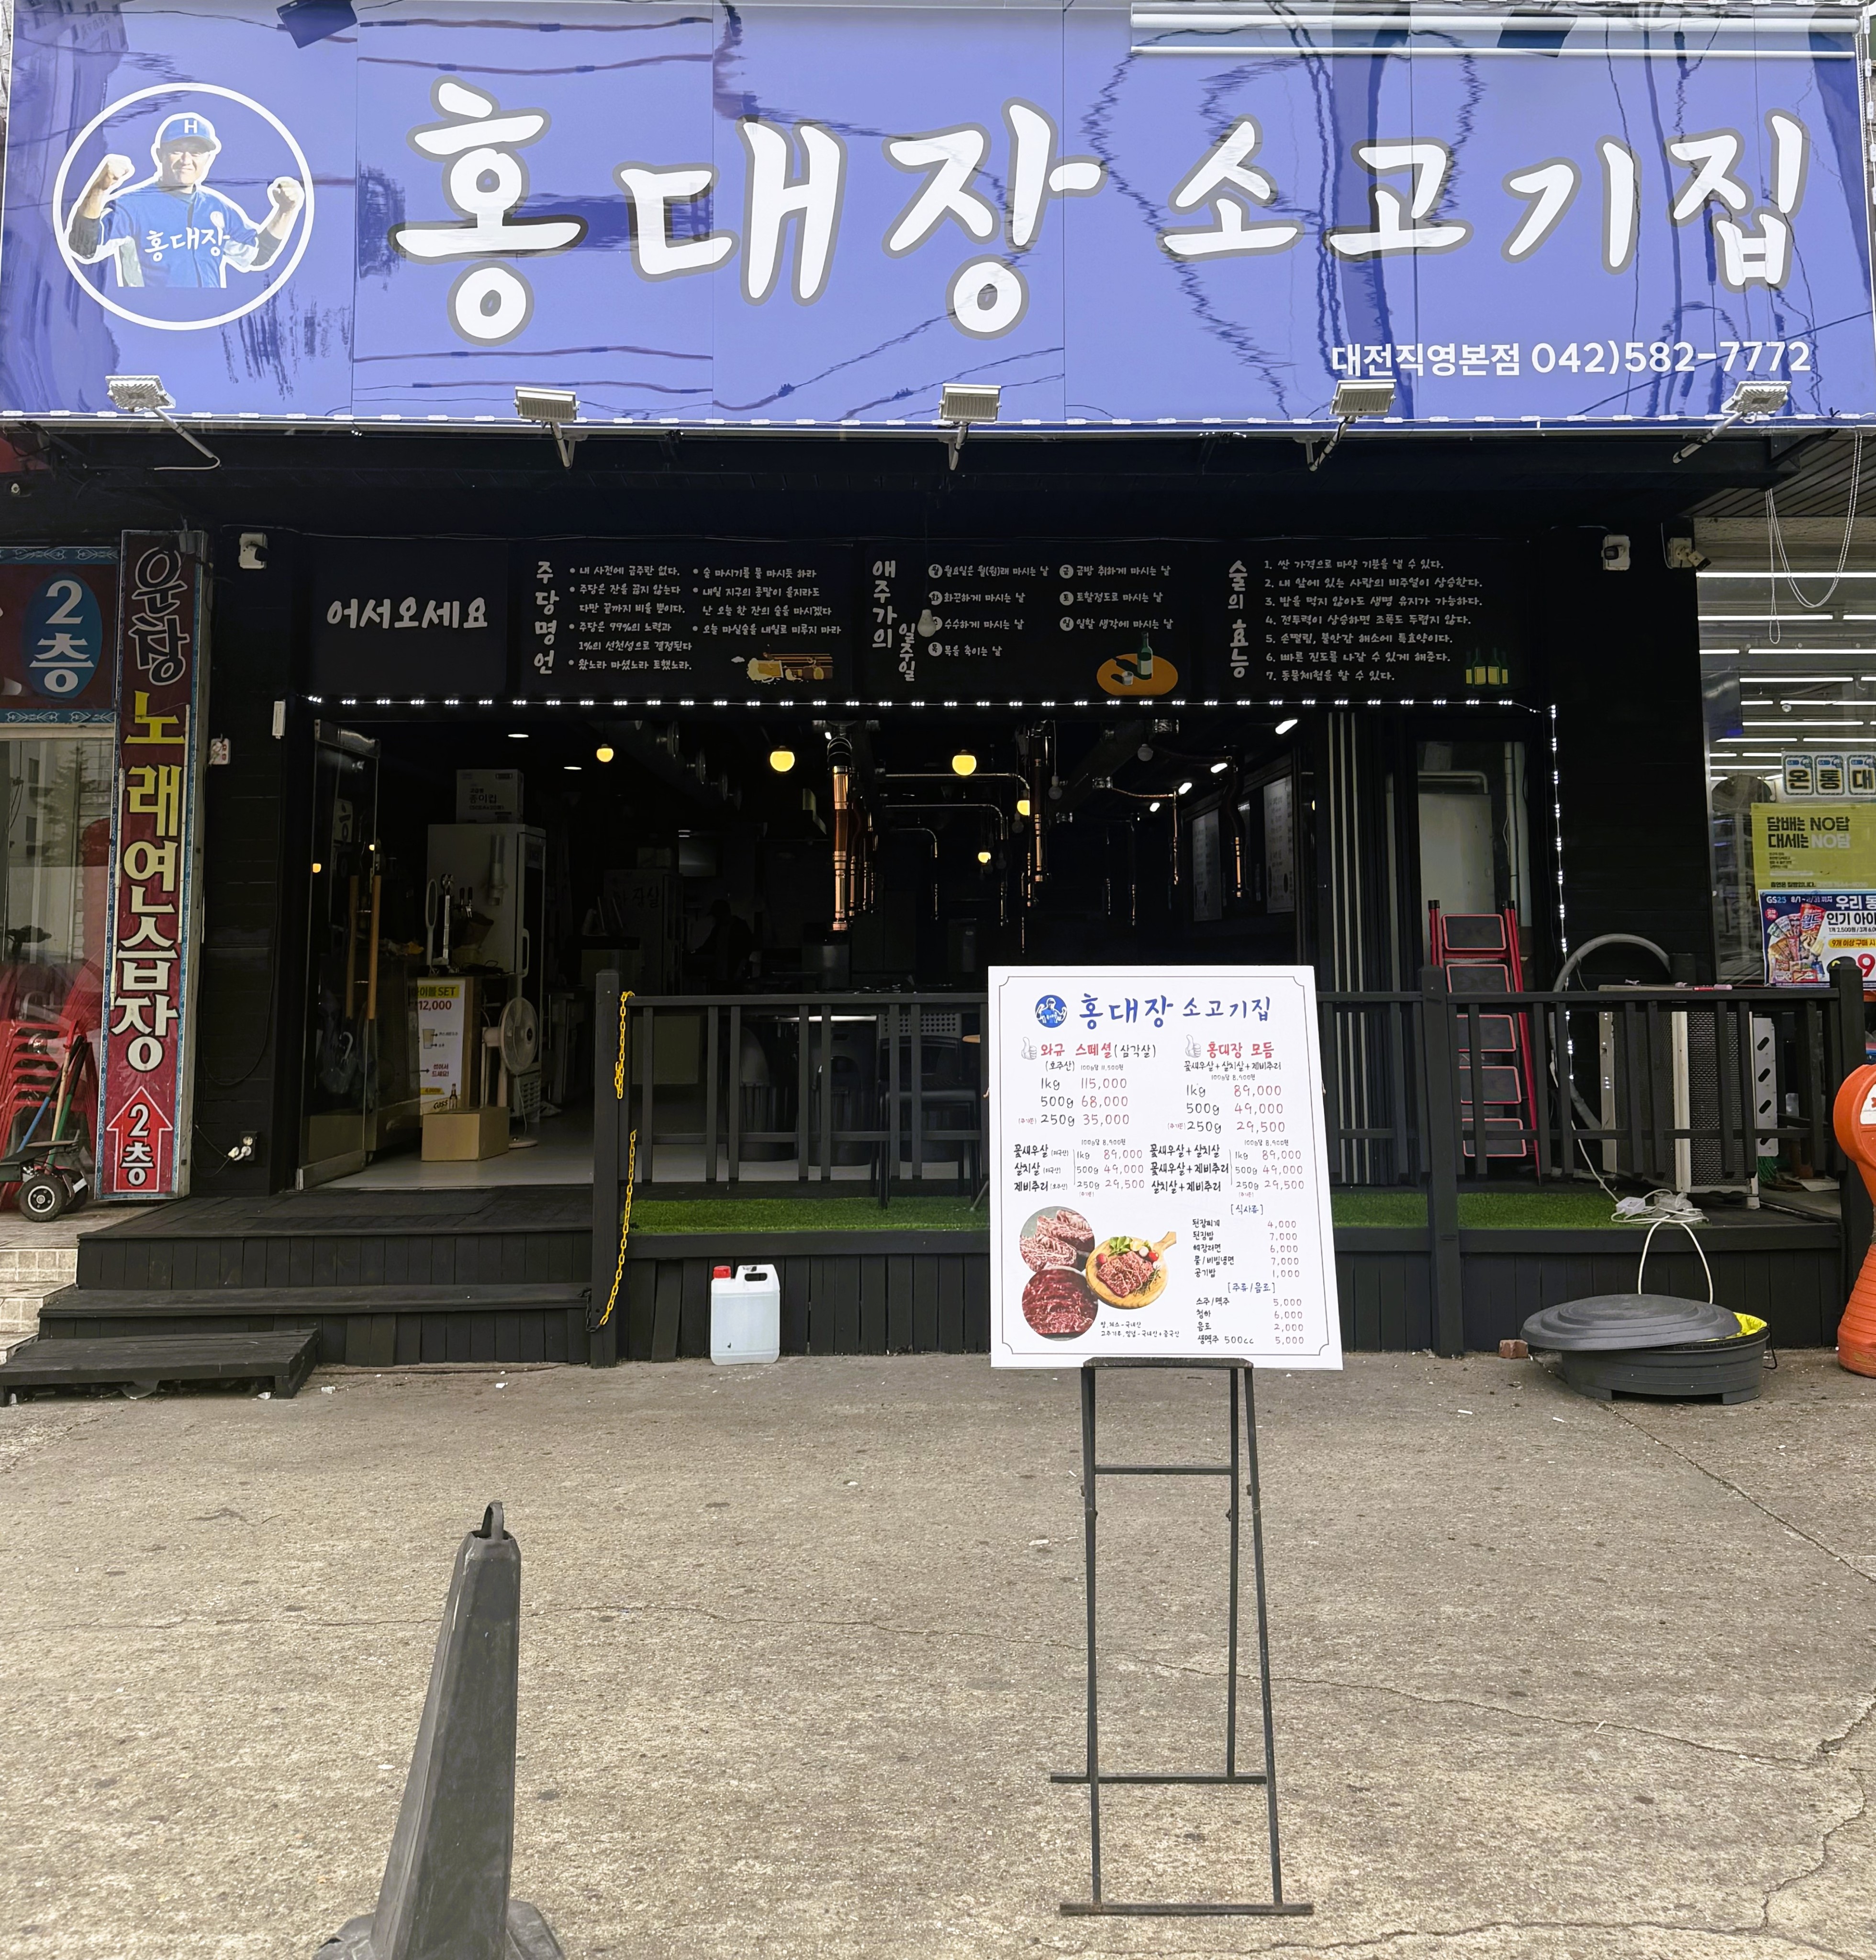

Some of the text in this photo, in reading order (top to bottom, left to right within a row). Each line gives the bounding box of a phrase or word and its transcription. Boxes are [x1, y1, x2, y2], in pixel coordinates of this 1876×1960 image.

[184, 119, 197, 133] H
[395, 78, 1809, 341] 홍대장 소고기집
[145, 227, 230, 262] 홍대장
[1331, 341, 1811, 377] 대전직영본점 042)582-7772
[1295, 558, 1388, 569] 가격으로 기분을
[594, 566, 679, 576] 사전에 금주란 없다.
[715, 567, 793, 578] 마시기를 마시듯
[944, 565, 973, 577] 월요일은
[1077, 565, 1126, 576] 금방 취하게
[1350, 577, 1482, 588] 사람의 비주얼이 상승한다.
[653, 584, 681, 595] 않는다
[726, 588, 750, 597] 지구의
[756, 586, 781, 597] 종말이
[944, 592, 981, 602] 화끈하게
[1077, 591, 1118, 602] 토할정도로
[1306, 596, 1482, 607] 먹지 않아도 생명 유지가 가능하다.
[604, 603, 685, 613] 끝까지 뿐이다.
[872, 560, 897, 648] 애주가의
[327, 597, 487, 628] 어서오세요
[794, 606, 831, 616] 마시겠다
[945, 619, 979, 629] 수수하게
[1077, 618, 1129, 629] 일할 생각에
[1228, 560, 1249, 678] 술의 효능
[1281, 614, 1471, 625] 전투력이 상승하면 조폭도 두렵지 않다.
[610, 622, 671, 632] 99%의 노력과
[792, 624, 816, 635] 미루지
[29, 579, 94, 692] 2층
[1281, 633, 1452, 644] 손떨림, 불안감 해소에 특효약이다.
[579, 640, 692, 651] 1%의 선천성으로 결정된다
[945, 645, 987, 656] 목을 축이는
[899, 623, 915, 681] 일주일
[1281, 651, 1450, 662] 빠른 진도를 나갈 있게 해준다.
[579, 659, 692, 670] 왔노라 마셨노라 토했노라.
[1282, 670, 1394, 681] 동물체험을 있다.
[1767, 816, 1805, 831] 담배는
[1768, 834, 1809, 848] 대세는
[111, 690, 186, 1073] 노래연습장
[1836, 895, 1862, 910] 우리
[1827, 913, 1850, 925] 인기
[439, 987, 456, 996] SET
[1079, 993, 1270, 1030] 홍대장 소고기집
[1041, 1043, 1065, 1057] 와규
[1207, 1041, 1274, 1059] 홍대장 모듬
[1046, 1061, 1074, 1071] (호주산)
[1041, 1078, 1127, 1091] 1kg 115,000
[1187, 1084, 1281, 1097] 1kg 89,000
[1041, 1095, 1128, 1108] 500g 68,000
[1187, 1102, 1283, 1115] 500g 49,000
[1041, 1114, 1129, 1126] 250g 35,000
[1187, 1121, 1284, 1134] 250g 29,500
[121, 1102, 154, 1187] 2층
[1014, 1144, 1142, 1159] 꽃새우살 1kg 89,000
[1236, 1150, 1301, 1160] 1kg 89,000
[1015, 1162, 1143, 1176] 살치살 500g 49,000
[1236, 1165, 1302, 1175] 500g 49,000
[1014, 1180, 1144, 1192] 제비추리 250g 29,500
[1236, 1180, 1304, 1190] 250g 29,500
[1268, 1221, 1296, 1229] 4,000
[1270, 1233, 1297, 1241] 7,000
[1270, 1245, 1298, 1253] 6,000
[1271, 1258, 1298, 1266] 7,000
[1195, 1268, 1299, 1278] 공기밥 1,000
[1196, 1309, 1302, 1319] 청하 6,000
[1197, 1322, 1303, 1332] 음료 2,000
[1275, 1336, 1304, 1345] 5,000
